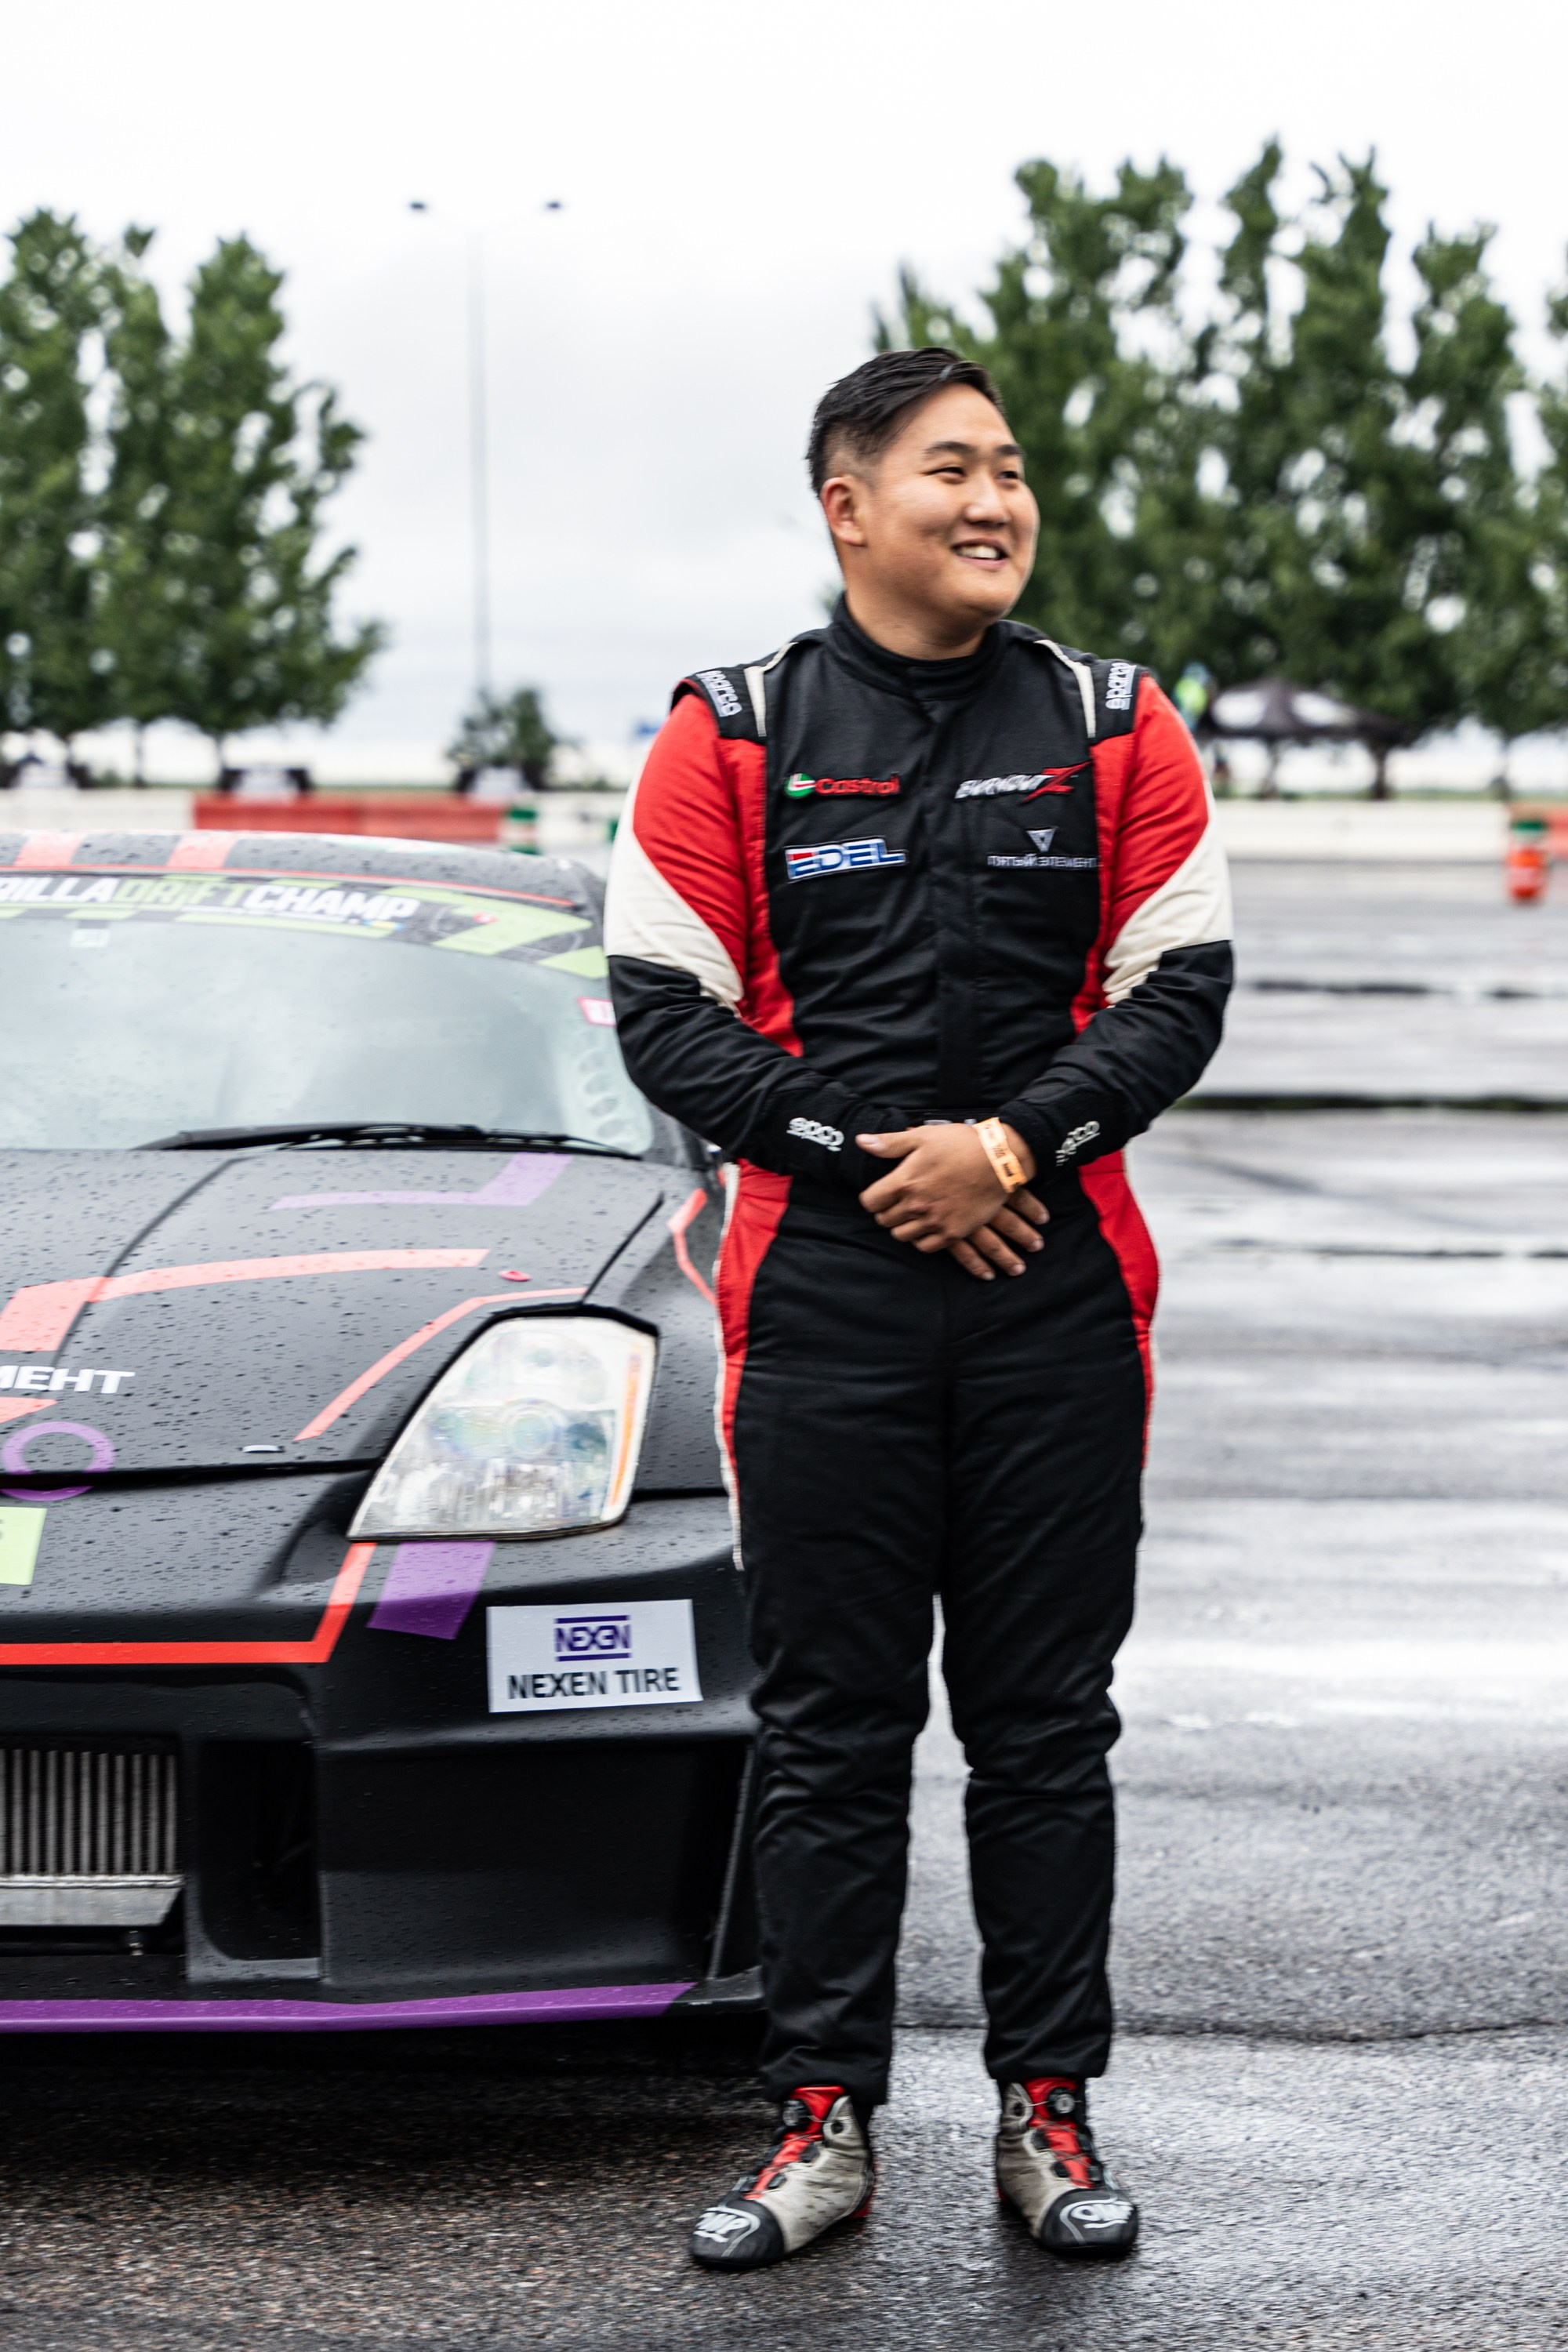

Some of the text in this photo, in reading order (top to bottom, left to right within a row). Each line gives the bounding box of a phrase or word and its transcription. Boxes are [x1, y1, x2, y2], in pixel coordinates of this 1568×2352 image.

[695, 670, 742, 717] sparco
[1105, 662, 1137, 710] sparco
[815, 774, 900, 794] Castrol
[786, 840, 904, 877] EDEL
[554, 1624, 631, 1652] NEXEN
[508, 1667, 681, 1699] NEXEN TIRE
